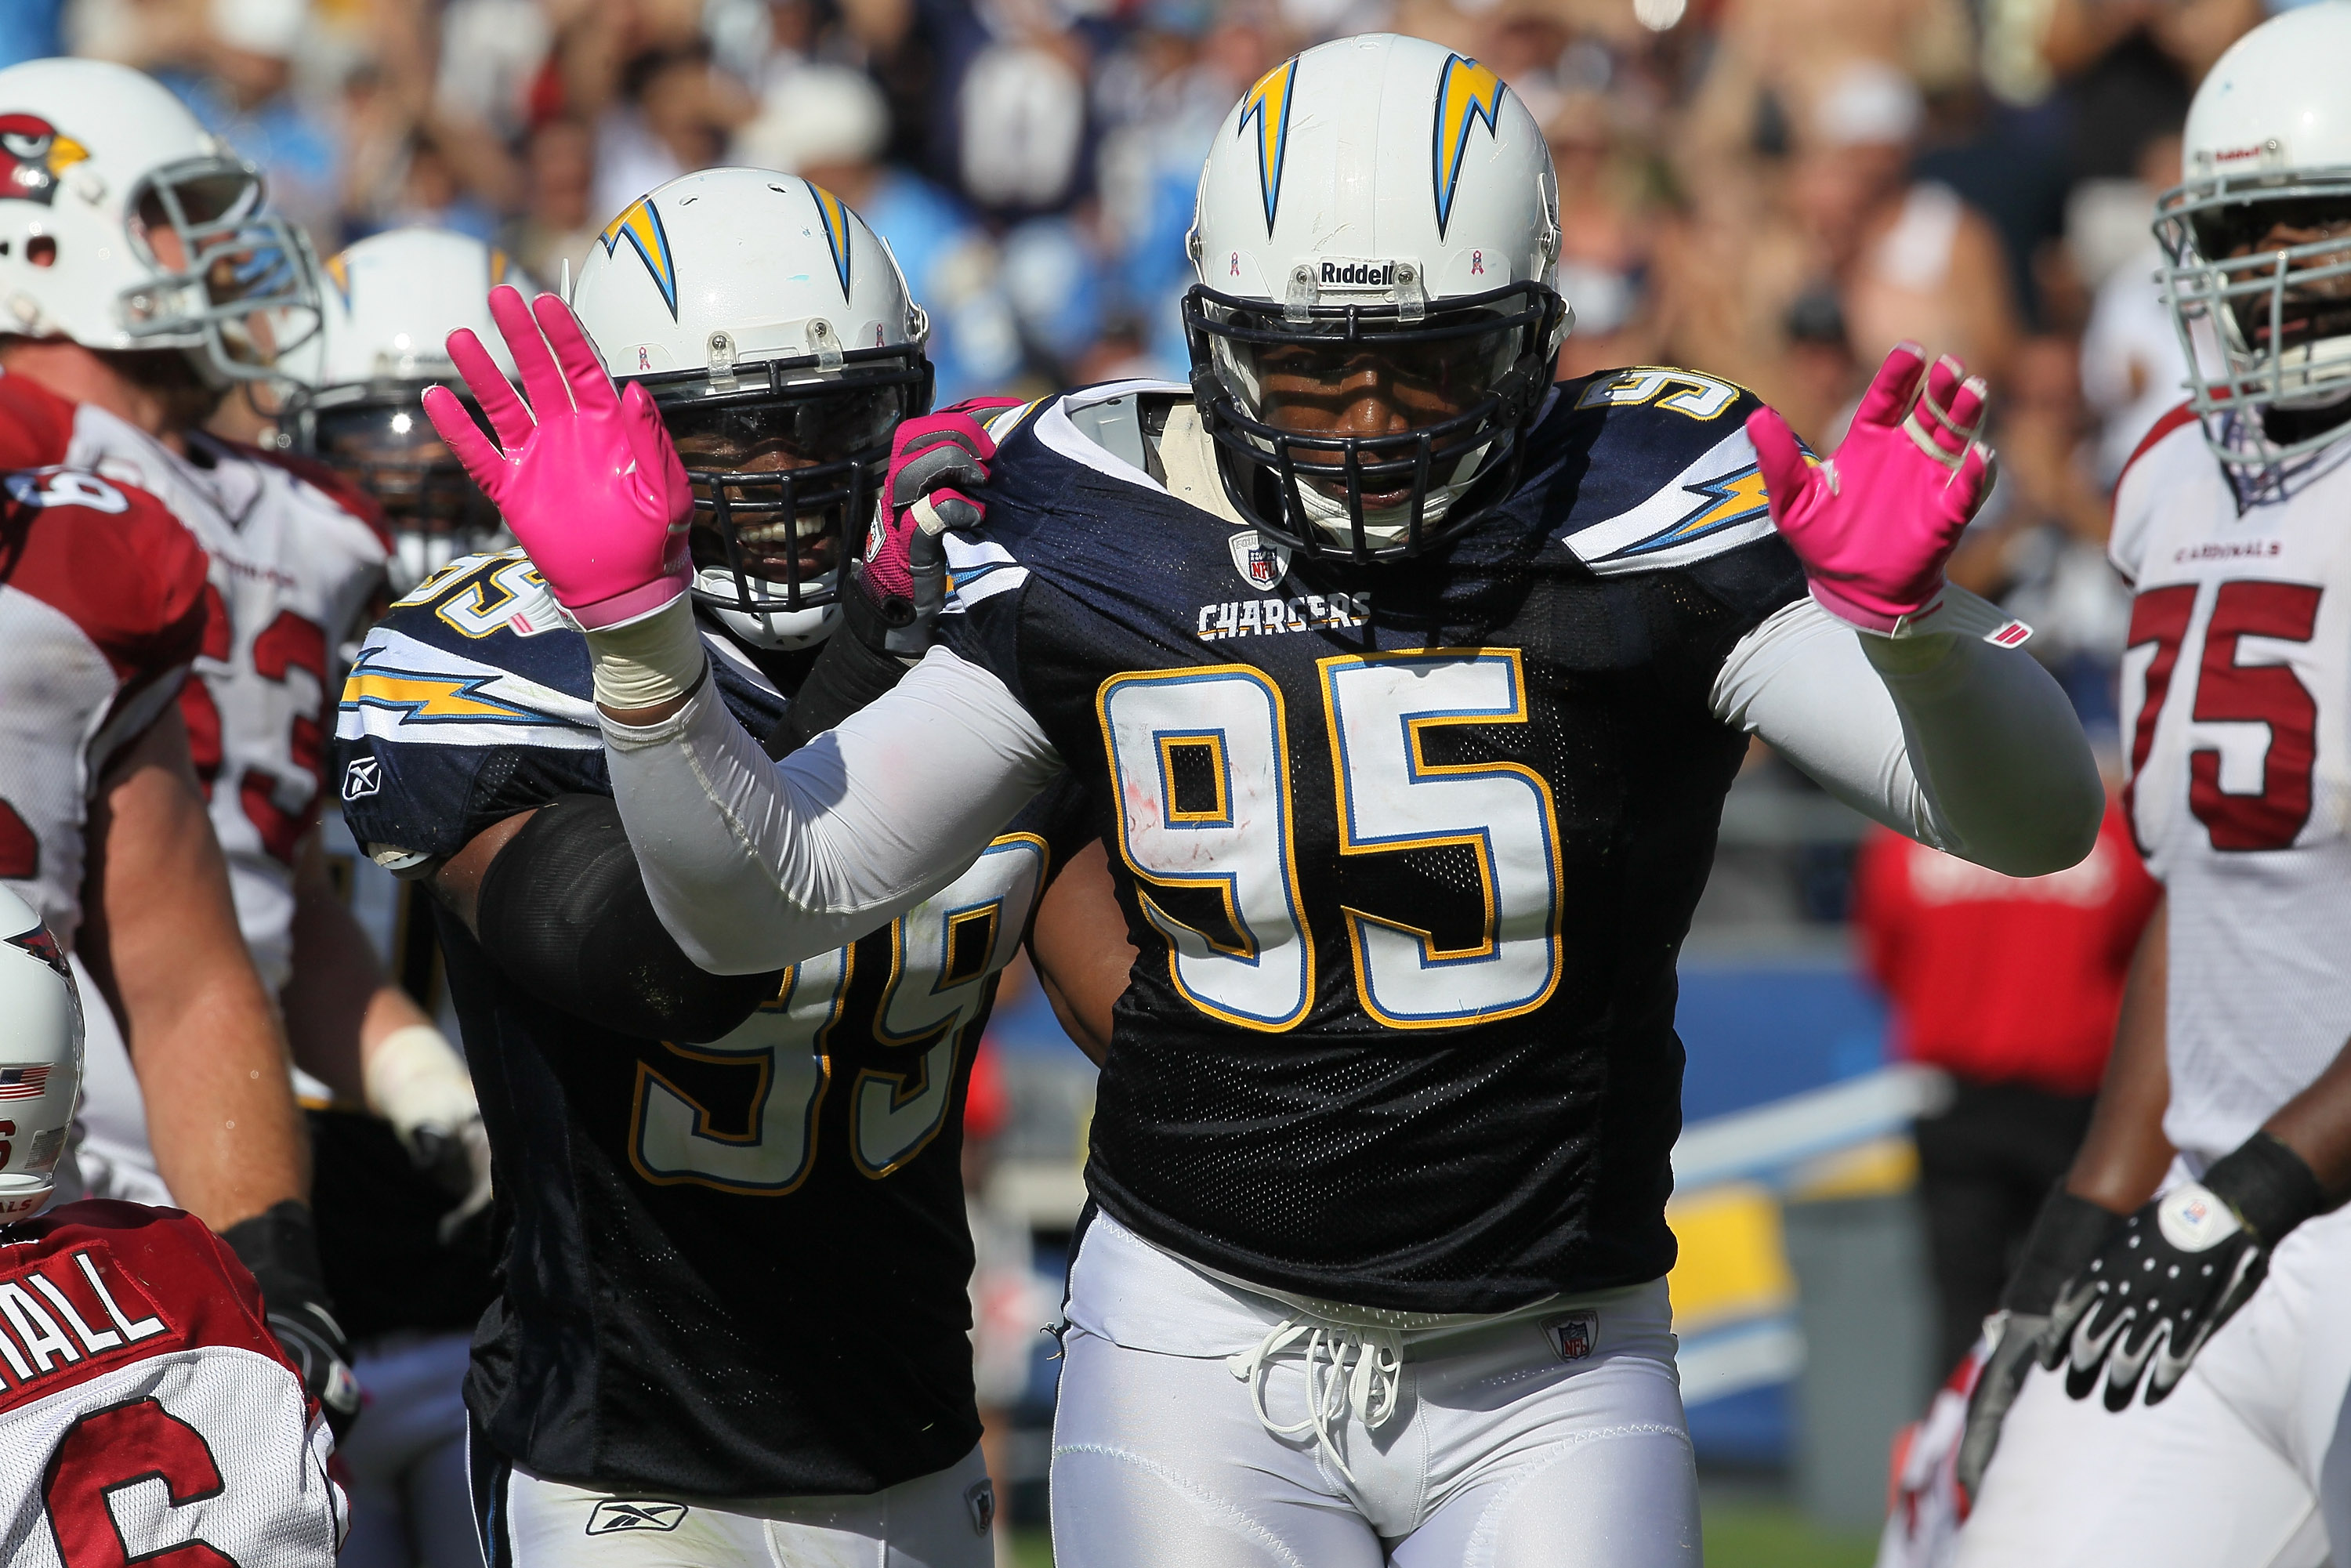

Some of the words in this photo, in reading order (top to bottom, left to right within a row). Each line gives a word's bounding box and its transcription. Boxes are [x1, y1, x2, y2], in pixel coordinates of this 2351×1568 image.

[1321, 262, 1393, 285] Riddell
[1252, 561, 1276, 580] NFL
[1197, 592, 1371, 642] CHARGERS
[2122, 580, 2325, 856] 75
[1097, 647, 1563, 1033] 95
